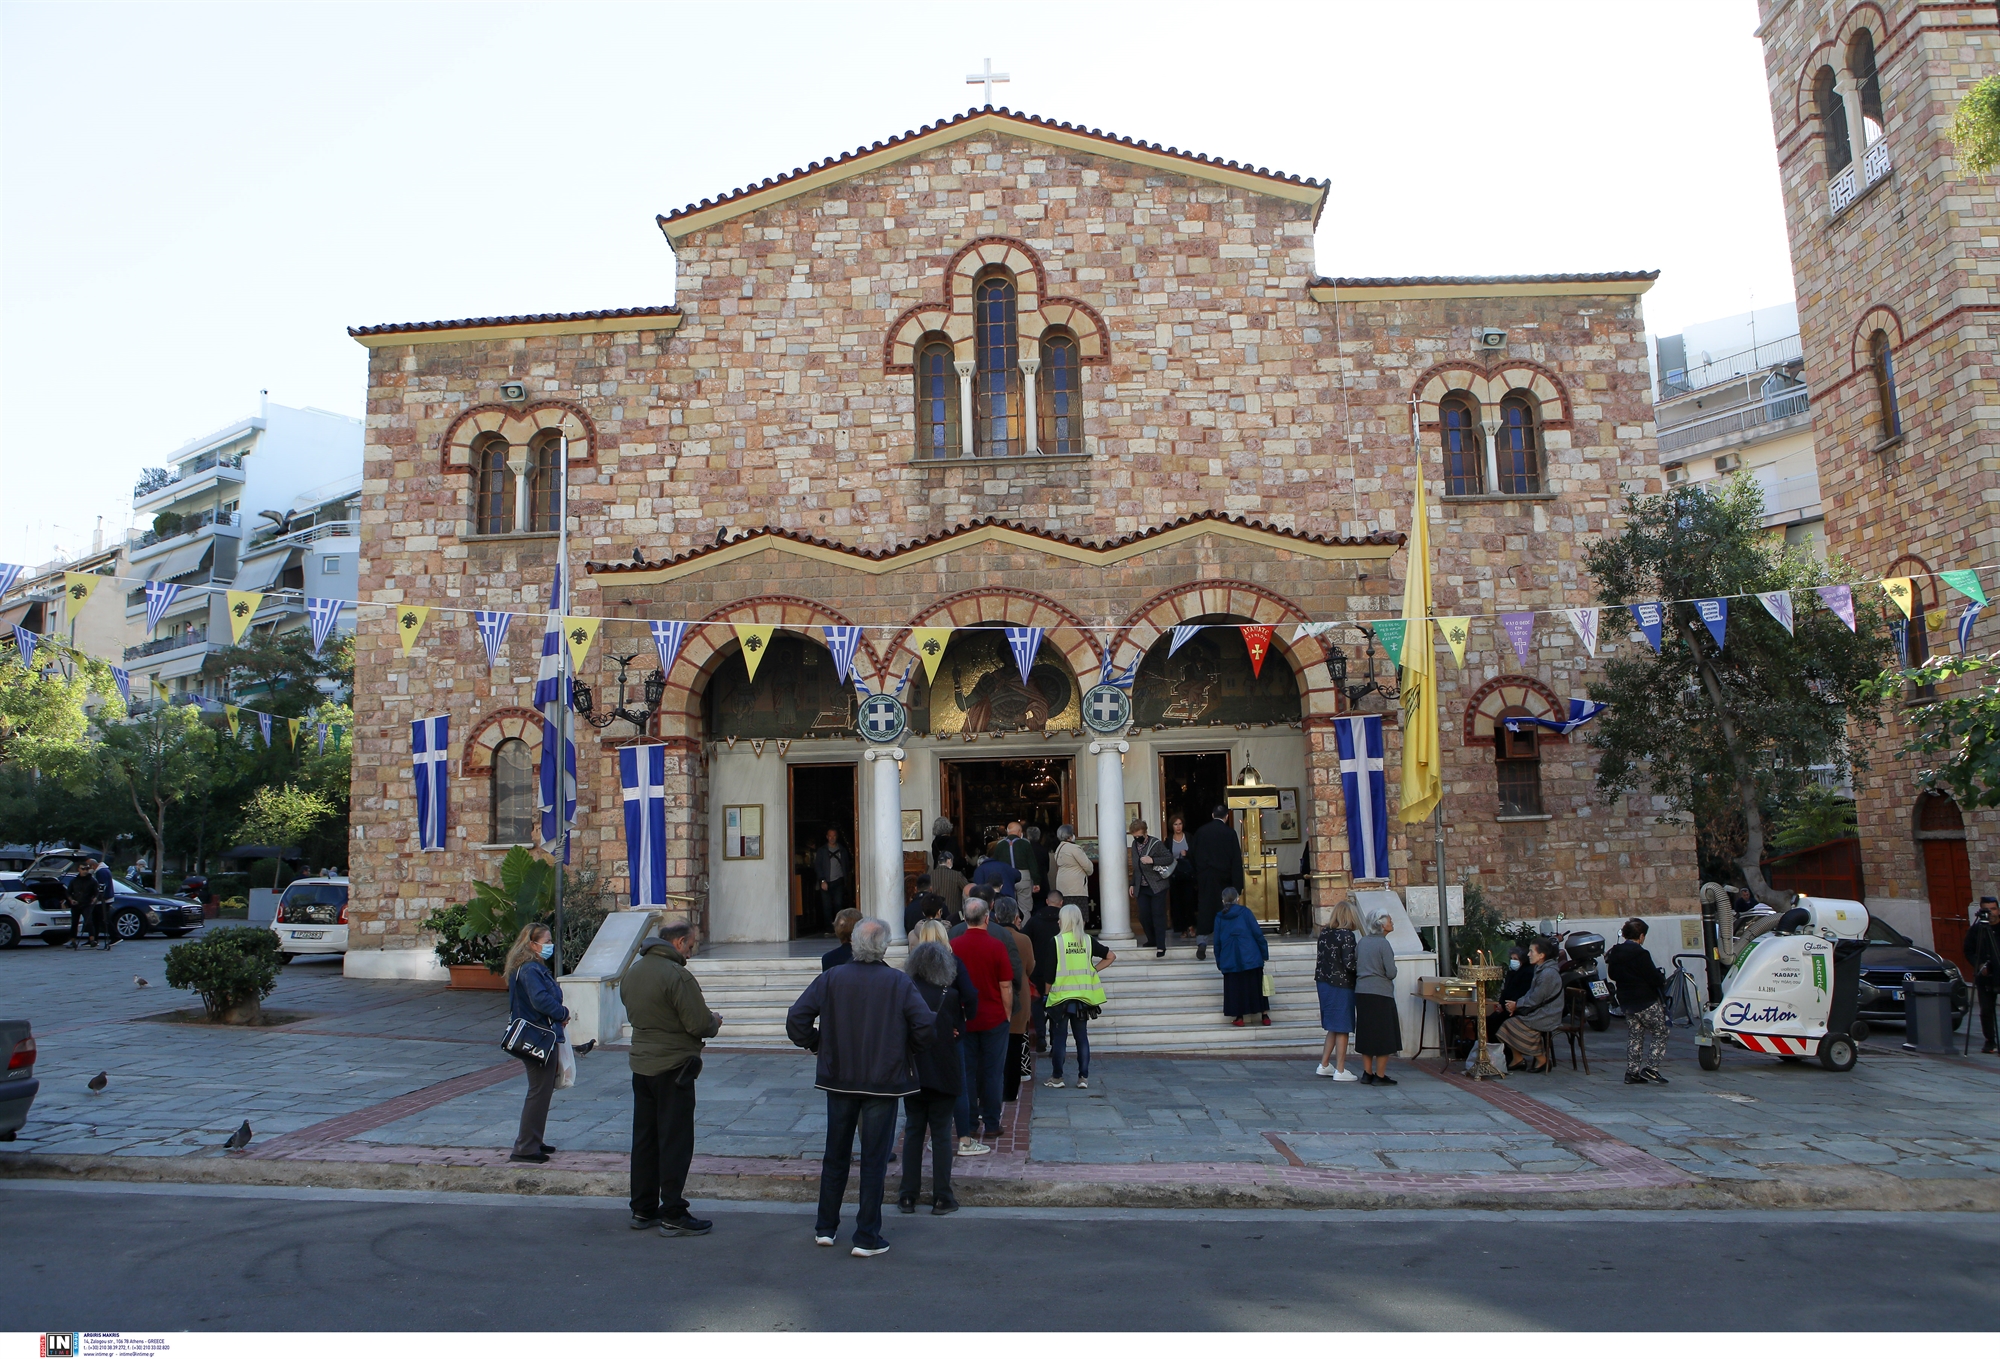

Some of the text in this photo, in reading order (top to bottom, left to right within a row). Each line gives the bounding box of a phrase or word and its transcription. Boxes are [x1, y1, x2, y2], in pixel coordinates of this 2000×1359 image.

[1804, 942, 1828, 951] Glutton
[1721, 1002, 1797, 1026] Glutton
[522, 1042, 545, 1058] FILA
